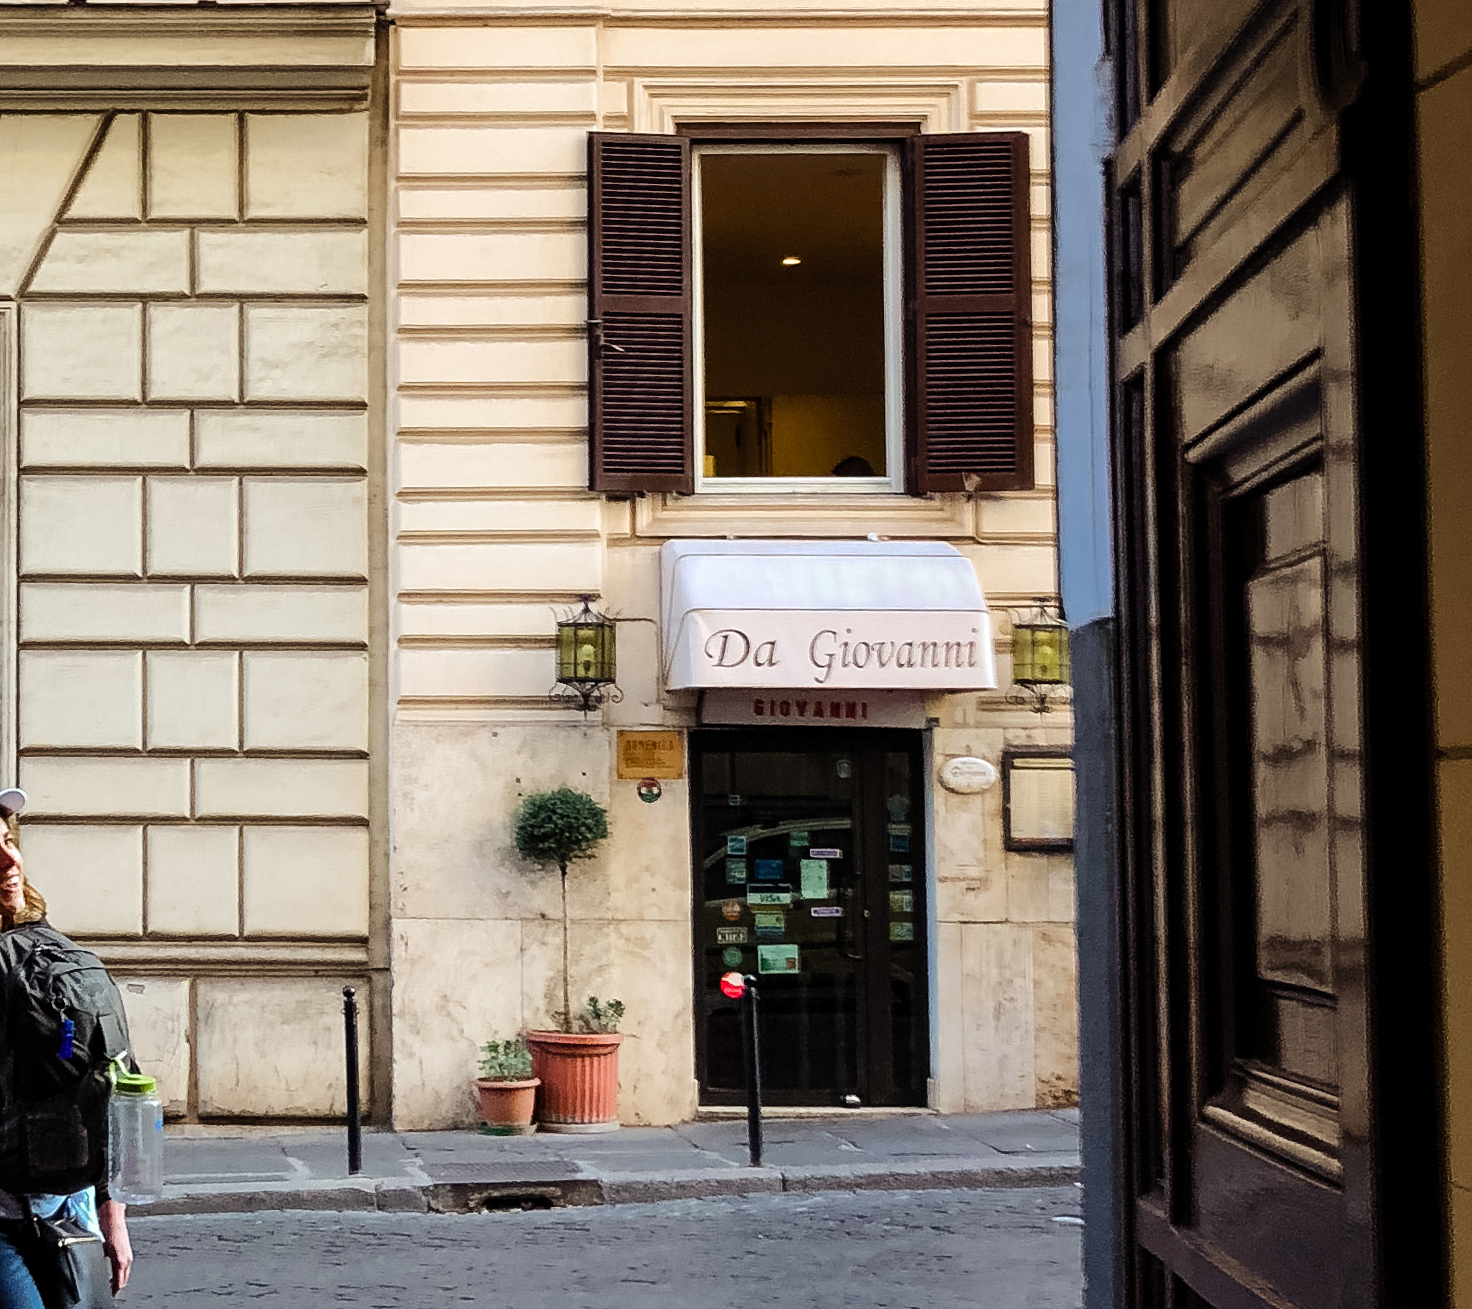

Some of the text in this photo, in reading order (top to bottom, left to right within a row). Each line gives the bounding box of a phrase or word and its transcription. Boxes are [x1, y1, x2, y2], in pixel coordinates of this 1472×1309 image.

[704, 627, 979, 684] Da Giovanni
[752, 698, 869, 719] GIOVANNI
[759, 893, 781, 903] VISA
